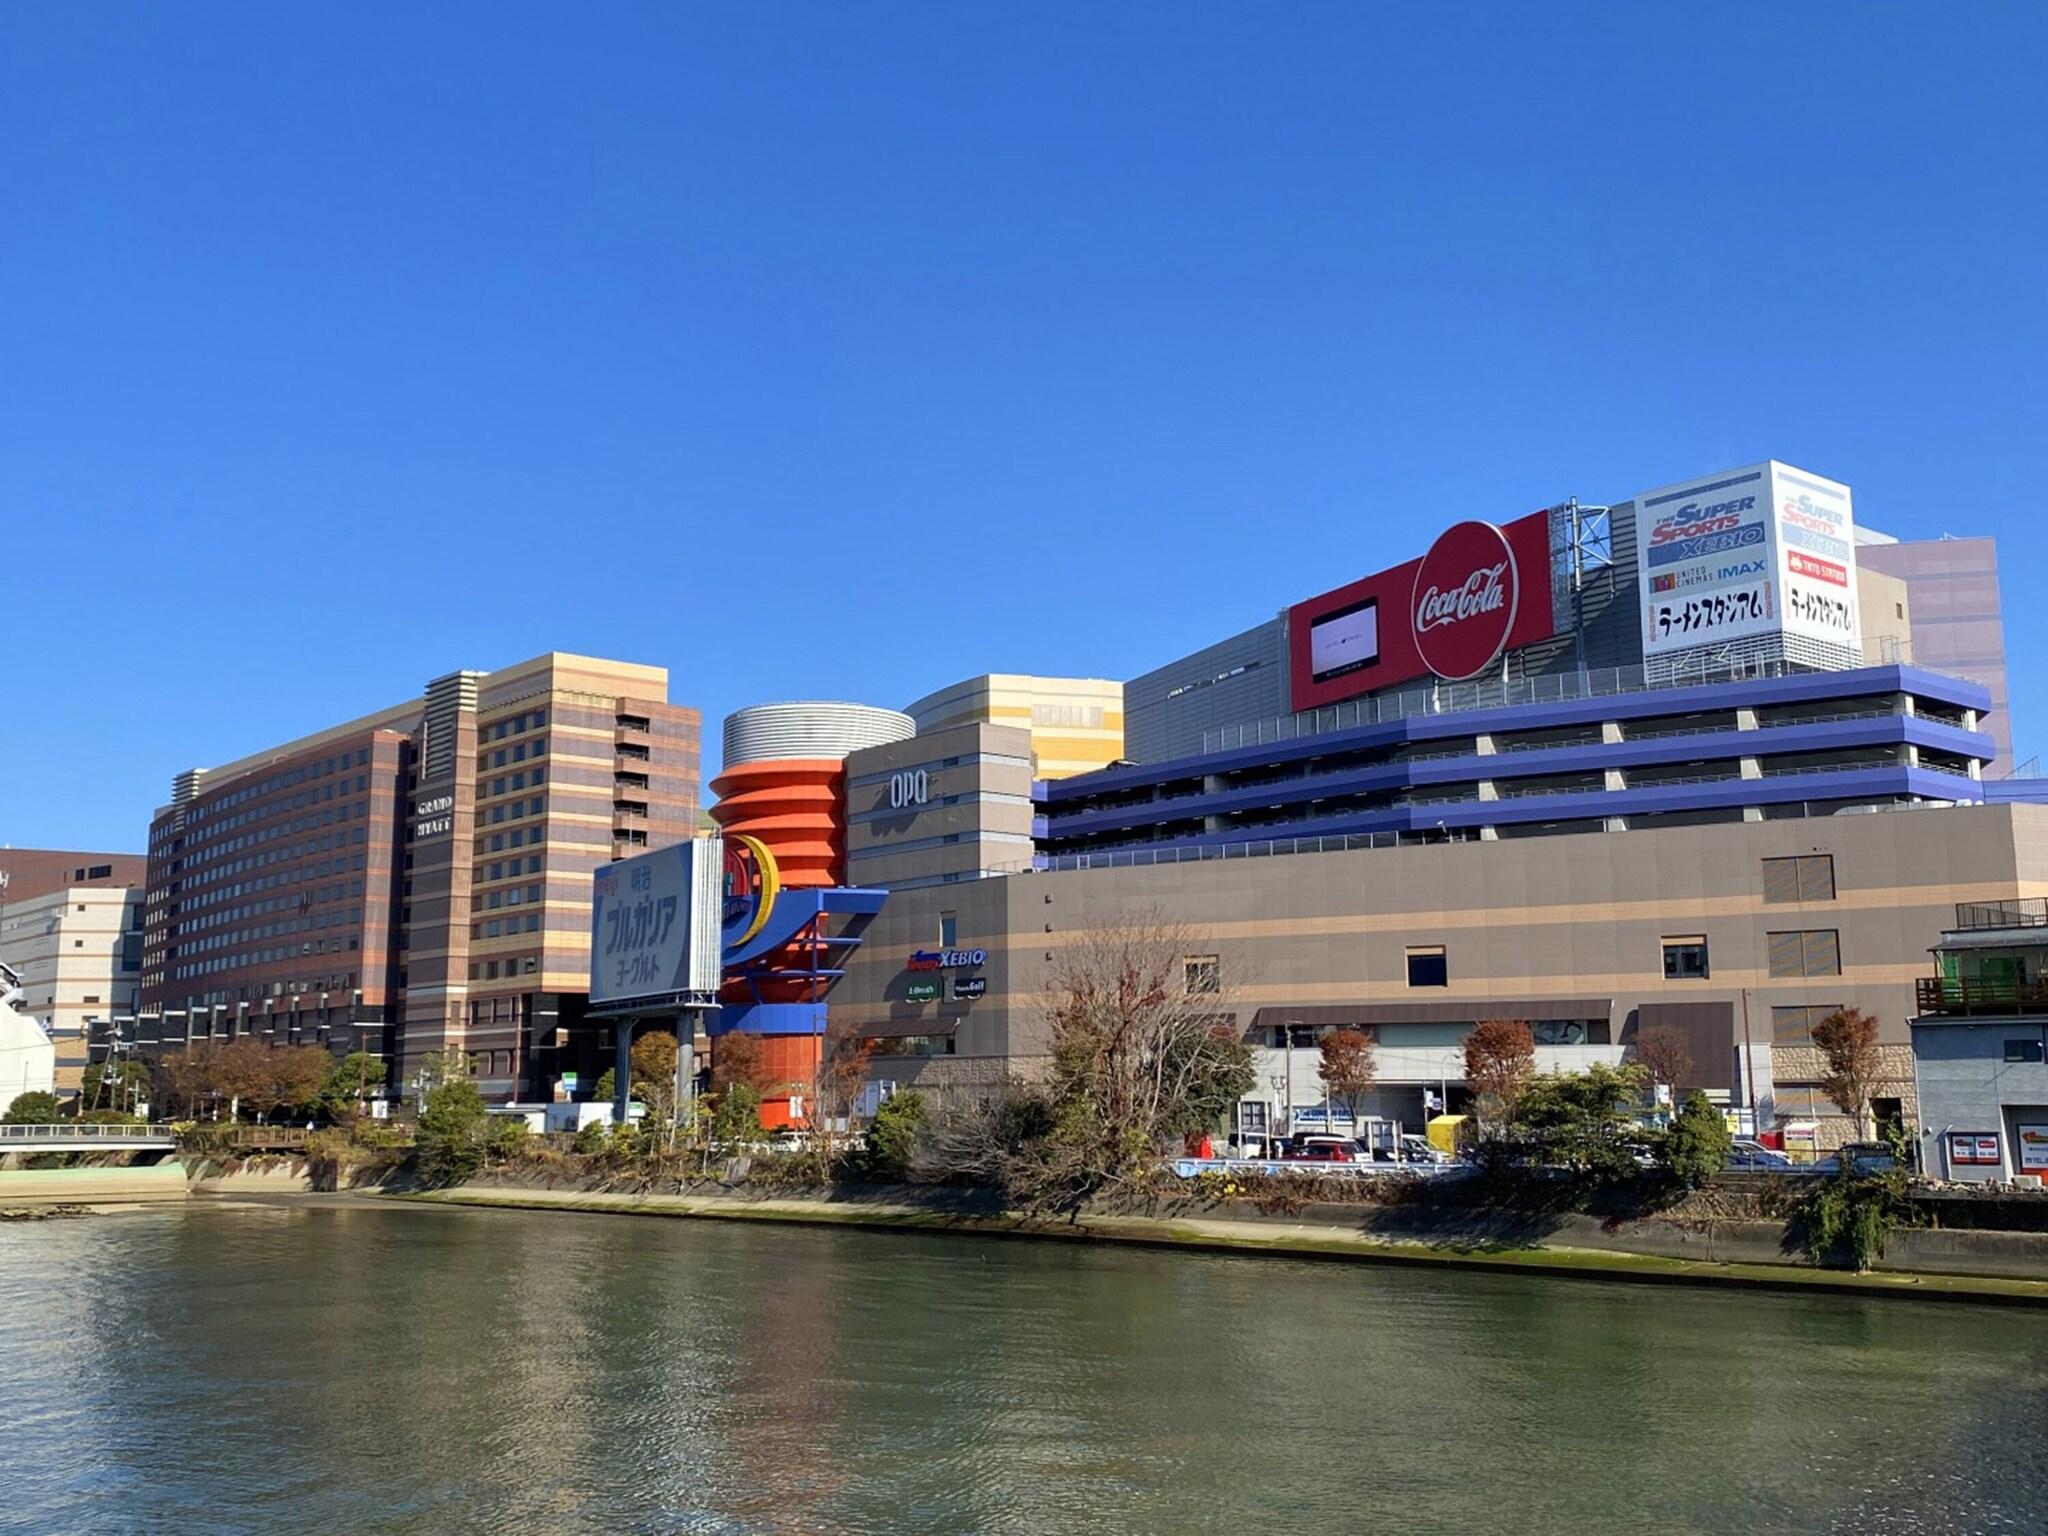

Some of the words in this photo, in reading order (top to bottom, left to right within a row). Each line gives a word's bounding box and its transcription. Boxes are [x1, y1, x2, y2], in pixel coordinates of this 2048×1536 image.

[1674, 496, 1756, 526] SUPER
[1782, 503, 1835, 535] SPORTS
[1797, 494, 1843, 526] SUPER
[1649, 513, 1740, 546] SPORTS
[1679, 527, 1763, 559] XEBIO
[1676, 566, 1706, 580] UNITED
[1677, 572, 1713, 588] CINEMAS
[1718, 560, 1765, 579] IMAX
[1416, 560, 1508, 632] Coca-Cola
[1660, 590, 1762, 637] ラーメンスタジアム
[891, 769, 928, 809] OPA
[418, 796, 452, 815] GRAND
[418, 817, 451, 836] HYATT
[616, 952, 660, 987] ヨーグルト
[940, 950, 985, 967] XEBIO
